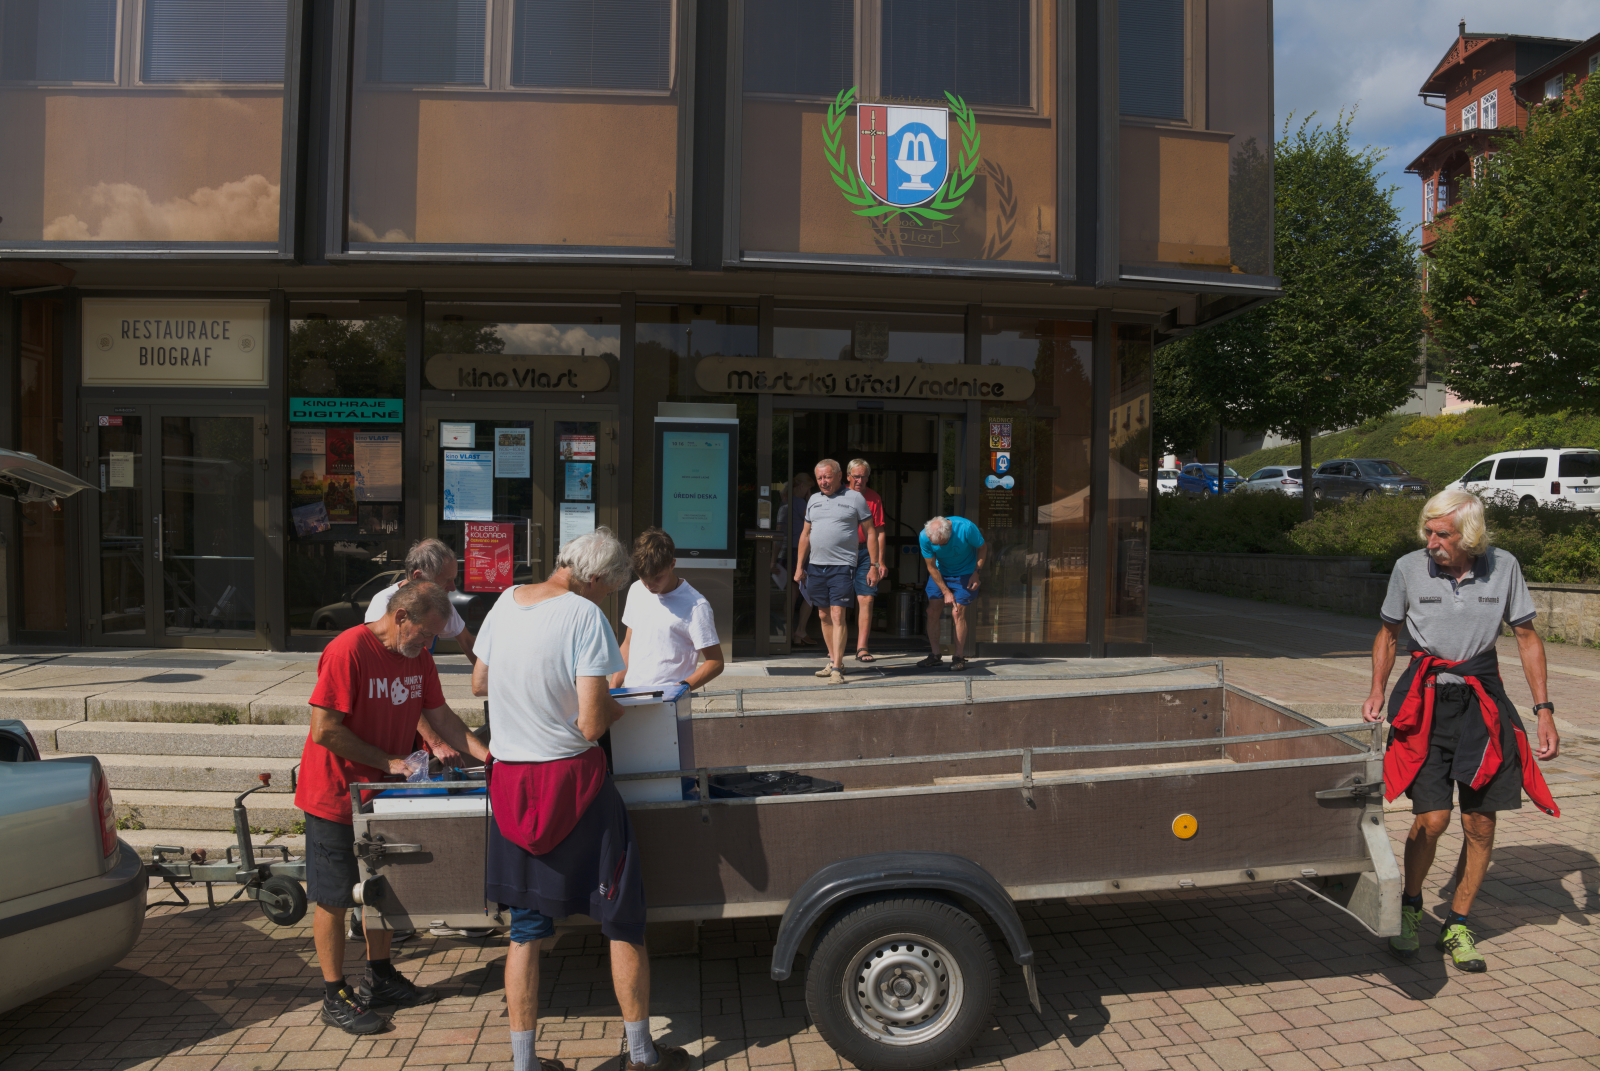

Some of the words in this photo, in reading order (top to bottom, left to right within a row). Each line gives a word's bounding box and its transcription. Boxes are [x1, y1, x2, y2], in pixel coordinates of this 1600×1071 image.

[870, 232, 908, 242] 1000
[911, 230, 936, 244] let
[121, 319, 231, 340] RESTAURACE
[139, 347, 213, 367] BIOGRAF
[458, 367, 509, 388] kino
[512, 367, 578, 388] Vlast
[727, 369, 837, 395] Městský
[293, 409, 400, 419] DIGITÁLNĚ
[988, 416, 1014, 424] RADNICE
[673, 491, 696, 499] ÚŘEDNÍ
[470, 524, 500, 532] HUDEBNÍ
[470, 531, 507, 539] KOLONÁDA
[404, 675, 423, 685] HUNRY
[368, 677, 389, 699] I'M
